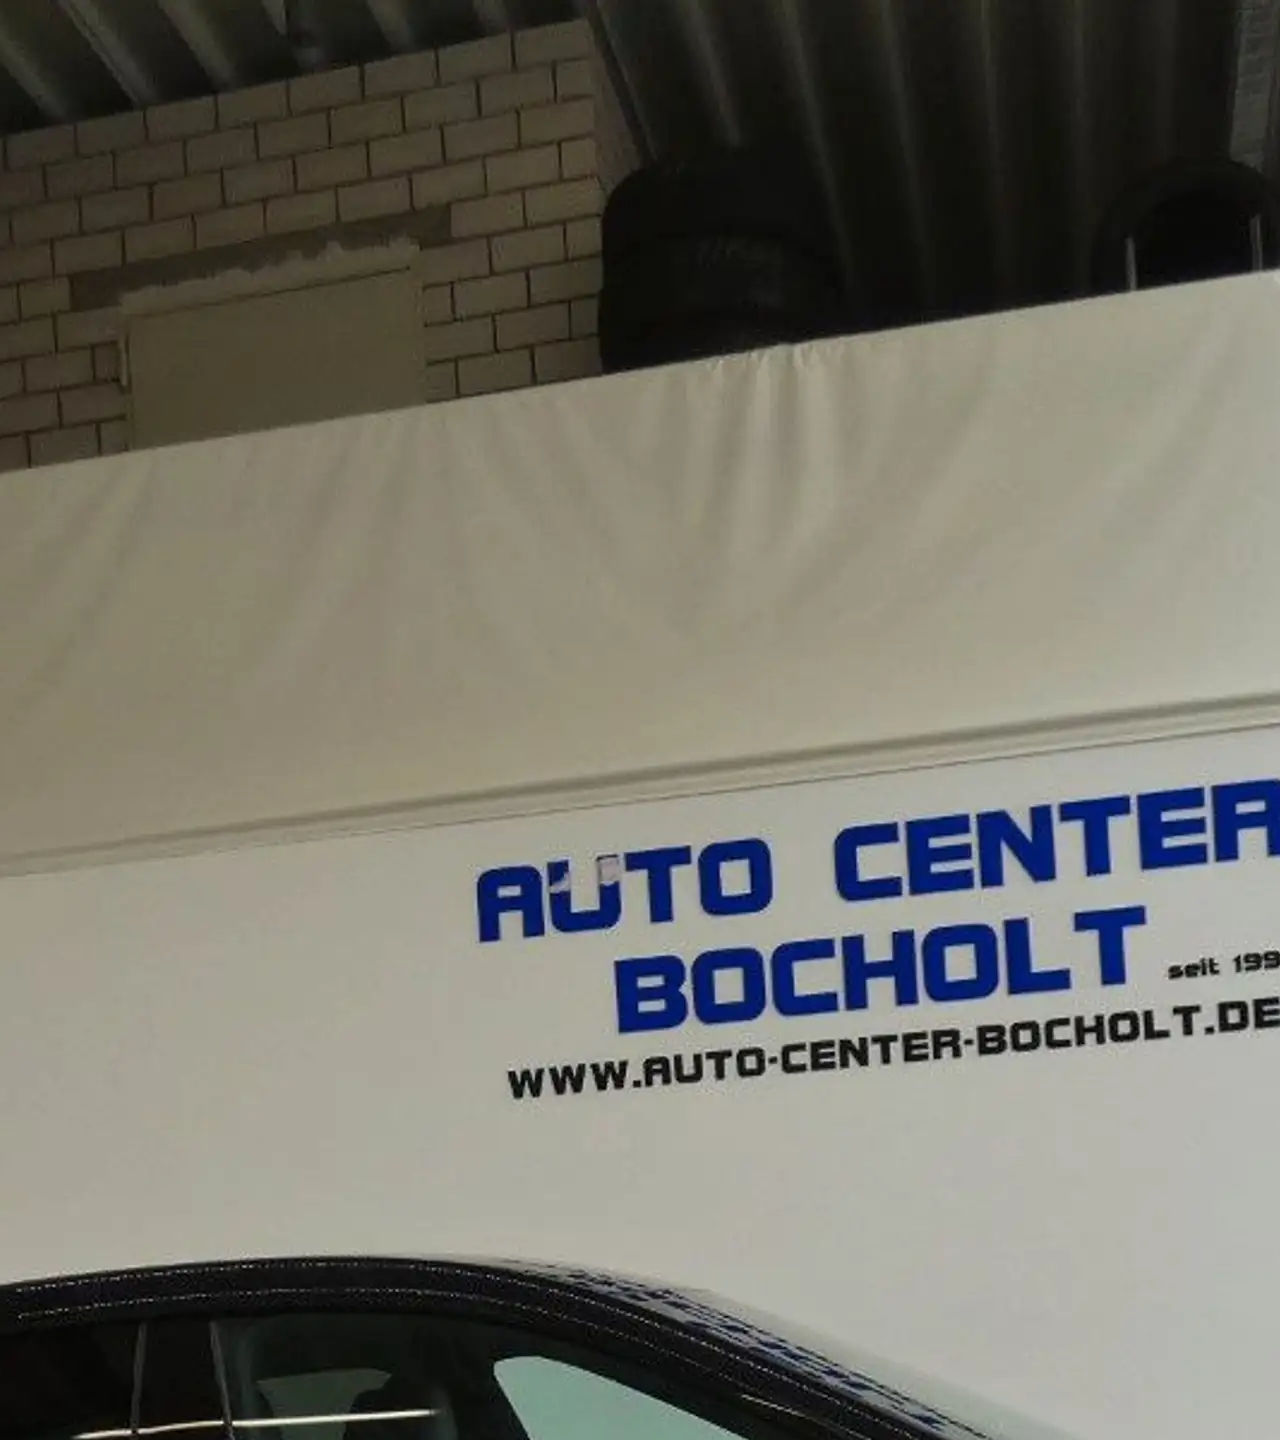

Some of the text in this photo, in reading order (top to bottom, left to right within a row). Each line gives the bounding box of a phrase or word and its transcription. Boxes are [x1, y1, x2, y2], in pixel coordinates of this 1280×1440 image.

[477, 838, 774, 943] AUTO
[614, 906, 1147, 1034] BOCHOLT
[1167, 956, 1221, 980] seit
